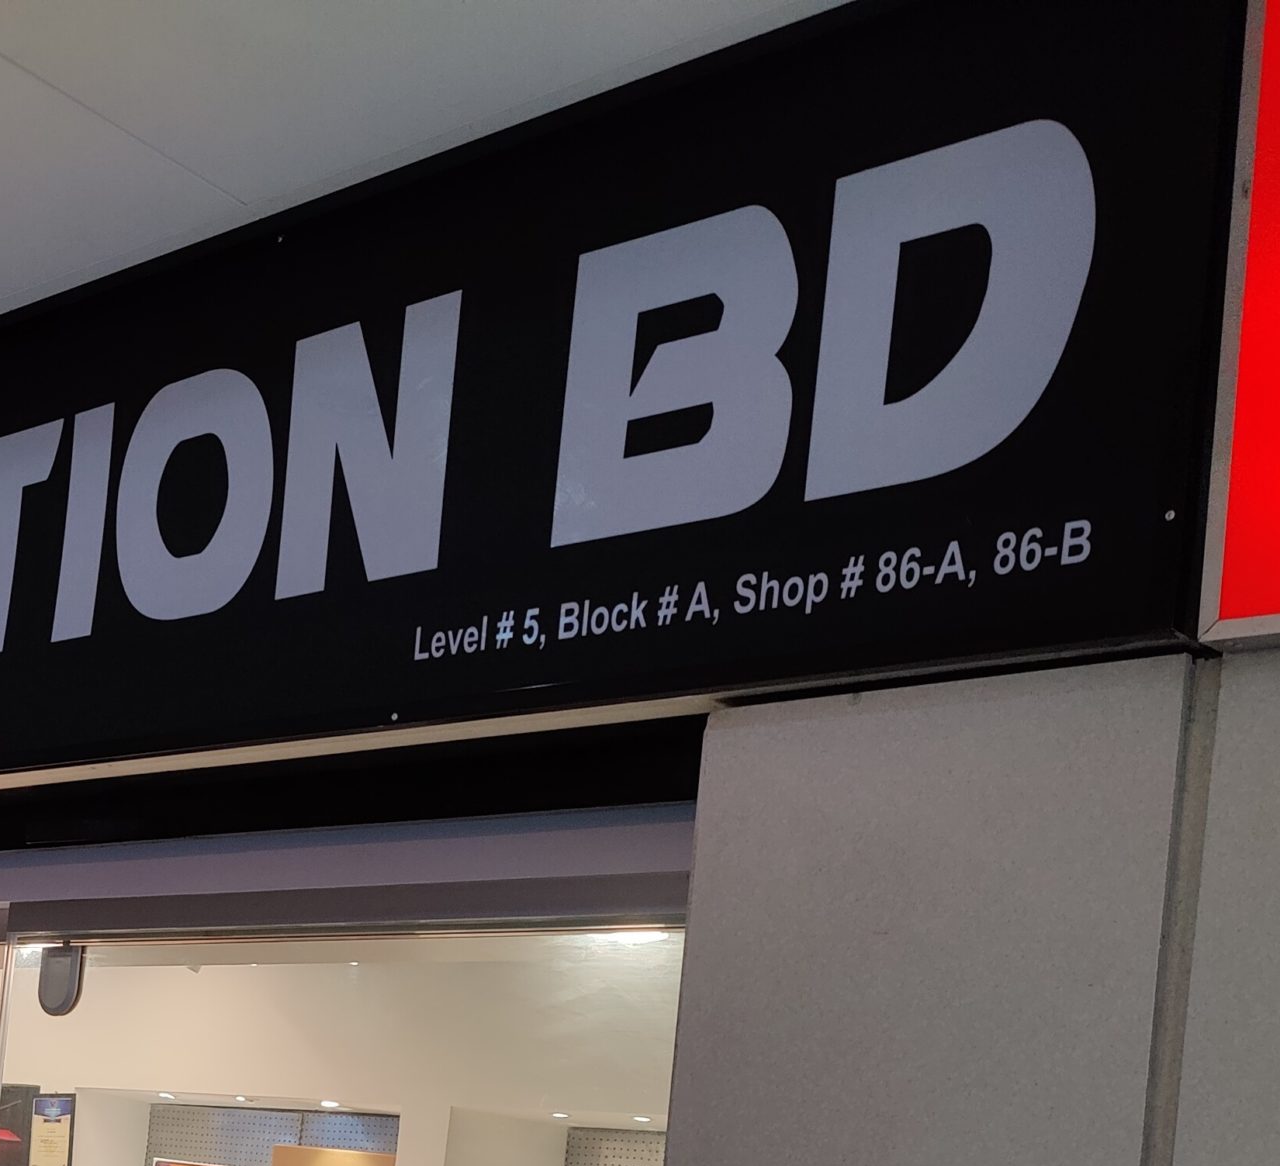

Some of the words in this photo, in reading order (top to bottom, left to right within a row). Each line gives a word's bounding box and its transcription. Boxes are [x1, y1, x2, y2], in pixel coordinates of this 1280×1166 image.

[550, 118, 1096, 548] BD
[414, 615, 488, 661] Level
[495, 610, 514, 649] #
[522, 608, 546, 650] 5,
[558, 592, 648, 640] Block
[657, 585, 679, 626] #
[685, 581, 720, 625] A,
[733, 571, 829, 614] Shop
[840, 555, 865, 599] #
[875, 540, 977, 587] 86-A,
[993, 519, 1092, 575] 86-B
